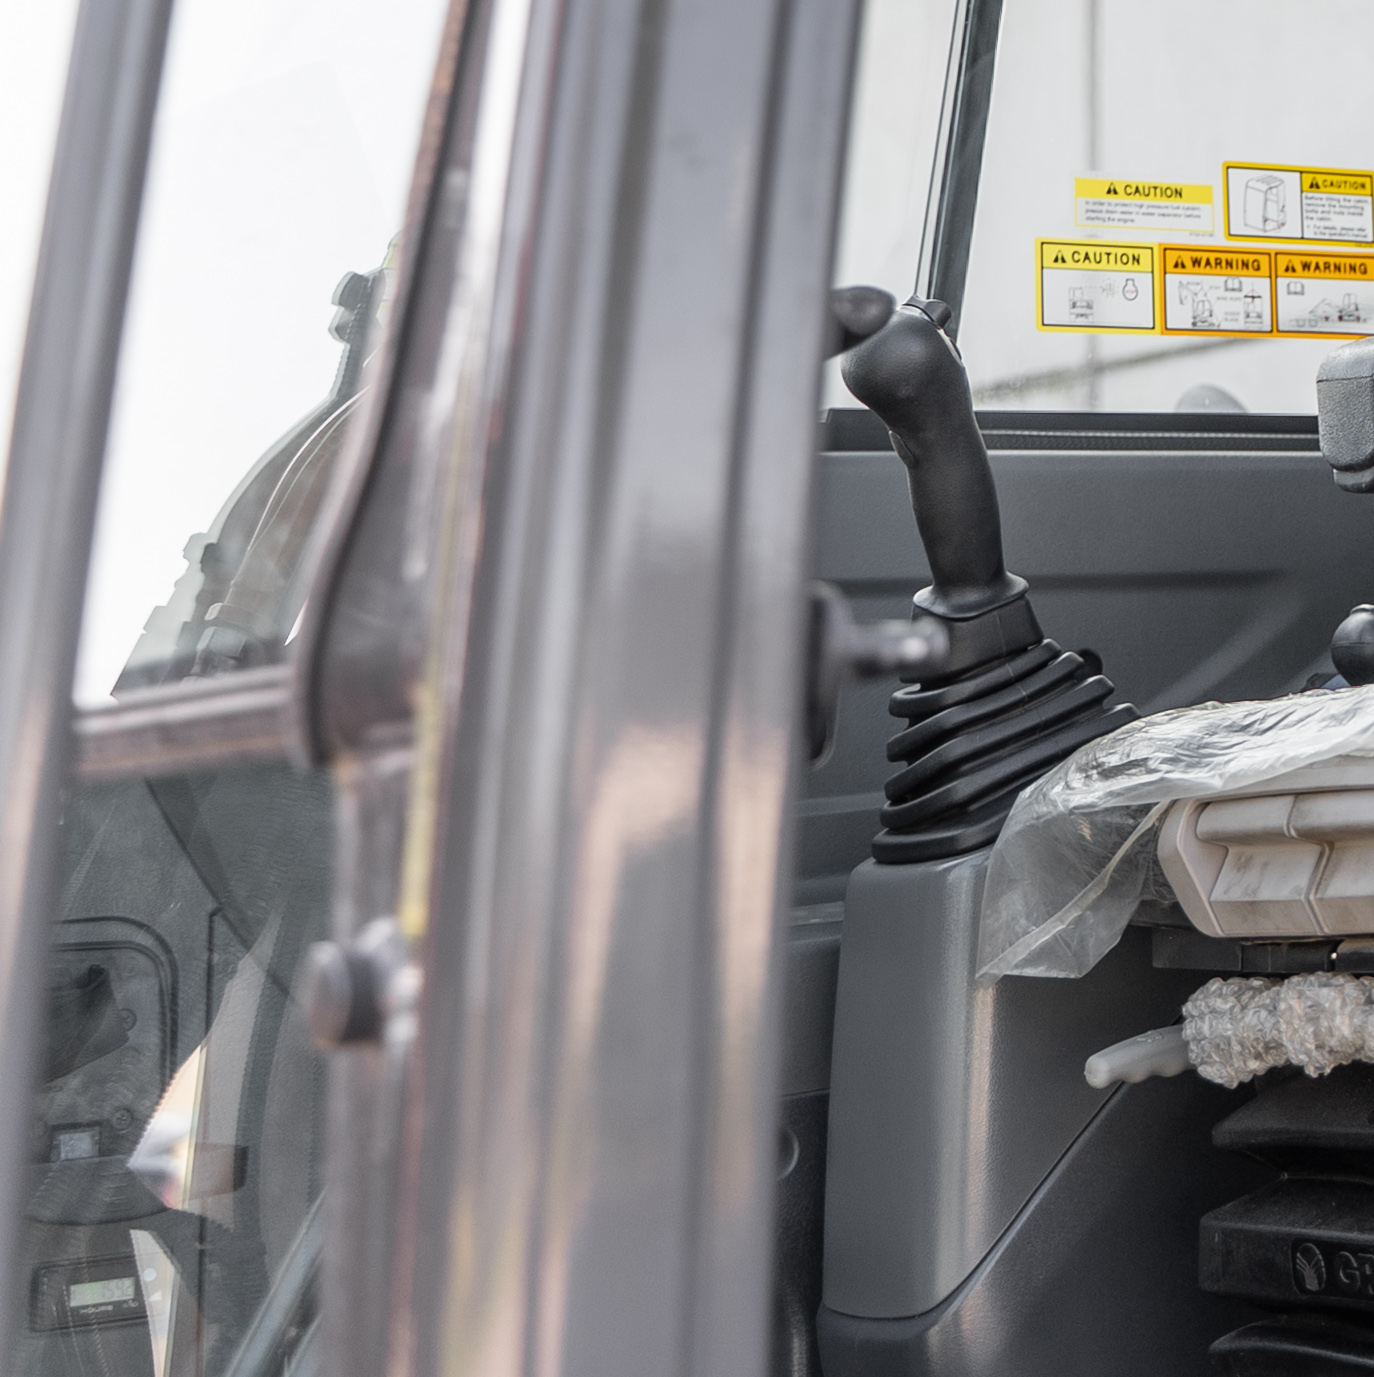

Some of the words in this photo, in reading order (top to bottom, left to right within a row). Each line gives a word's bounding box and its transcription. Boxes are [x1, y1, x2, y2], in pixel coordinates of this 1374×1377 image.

[1123, 184, 1183, 199] CAUTION
[1321, 180, 1367, 191] CAUTION
[1071, 250, 1141, 266] CAUTION
[1190, 256, 1261, 272] WARNING
[1301, 261, 1368, 275] WARNING
